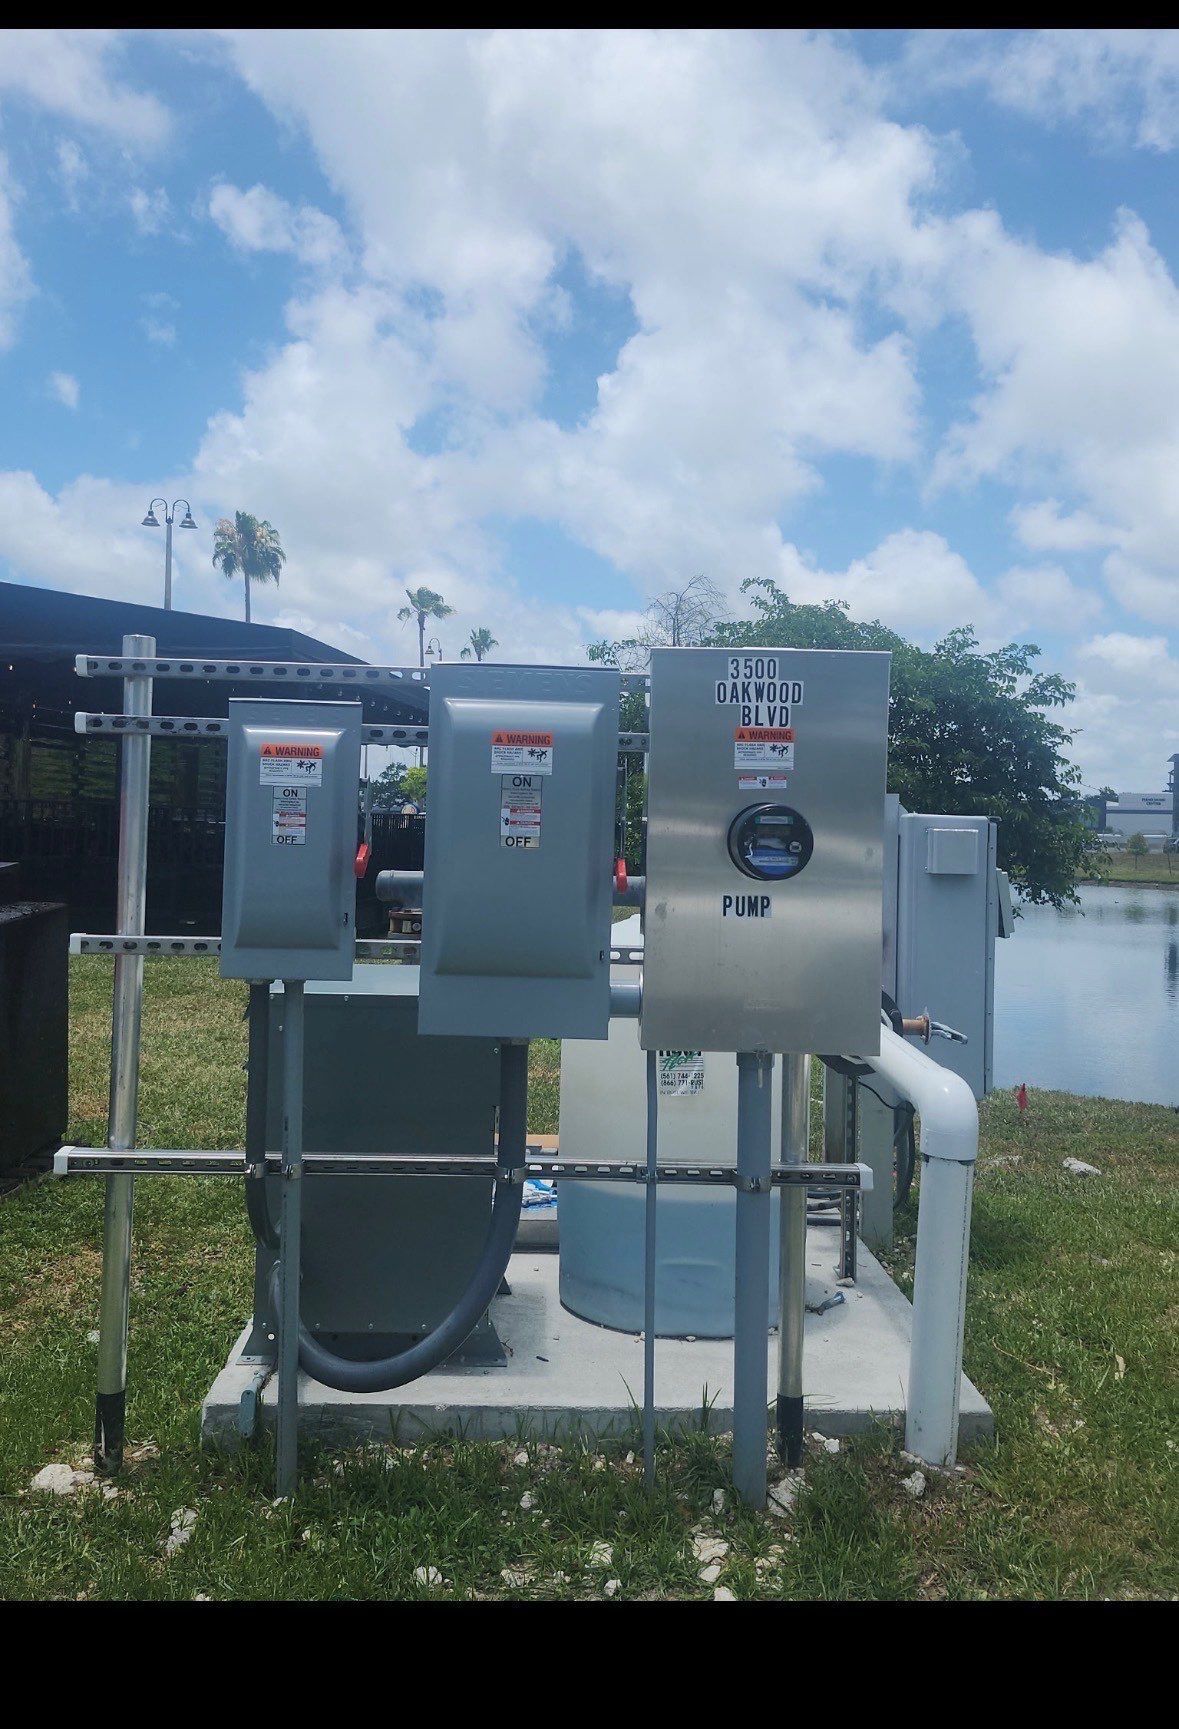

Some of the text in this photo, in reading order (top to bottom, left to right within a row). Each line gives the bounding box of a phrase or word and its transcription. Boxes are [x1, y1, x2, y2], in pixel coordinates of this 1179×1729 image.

[730, 658, 777, 680] 3500
[716, 681, 802, 704] OAKWOOD
[741, 706, 790, 727] BLVD
[508, 734, 550, 745] WARNING
[750, 731, 791, 741] WARNING
[276, 746, 320, 757] WARNING
[512, 776, 532, 787] ON
[283, 788, 298, 797] ON
[277, 835, 297, 844] OFF
[505, 836, 531, 847] OFF
[722, 895, 771, 917] PUMP
